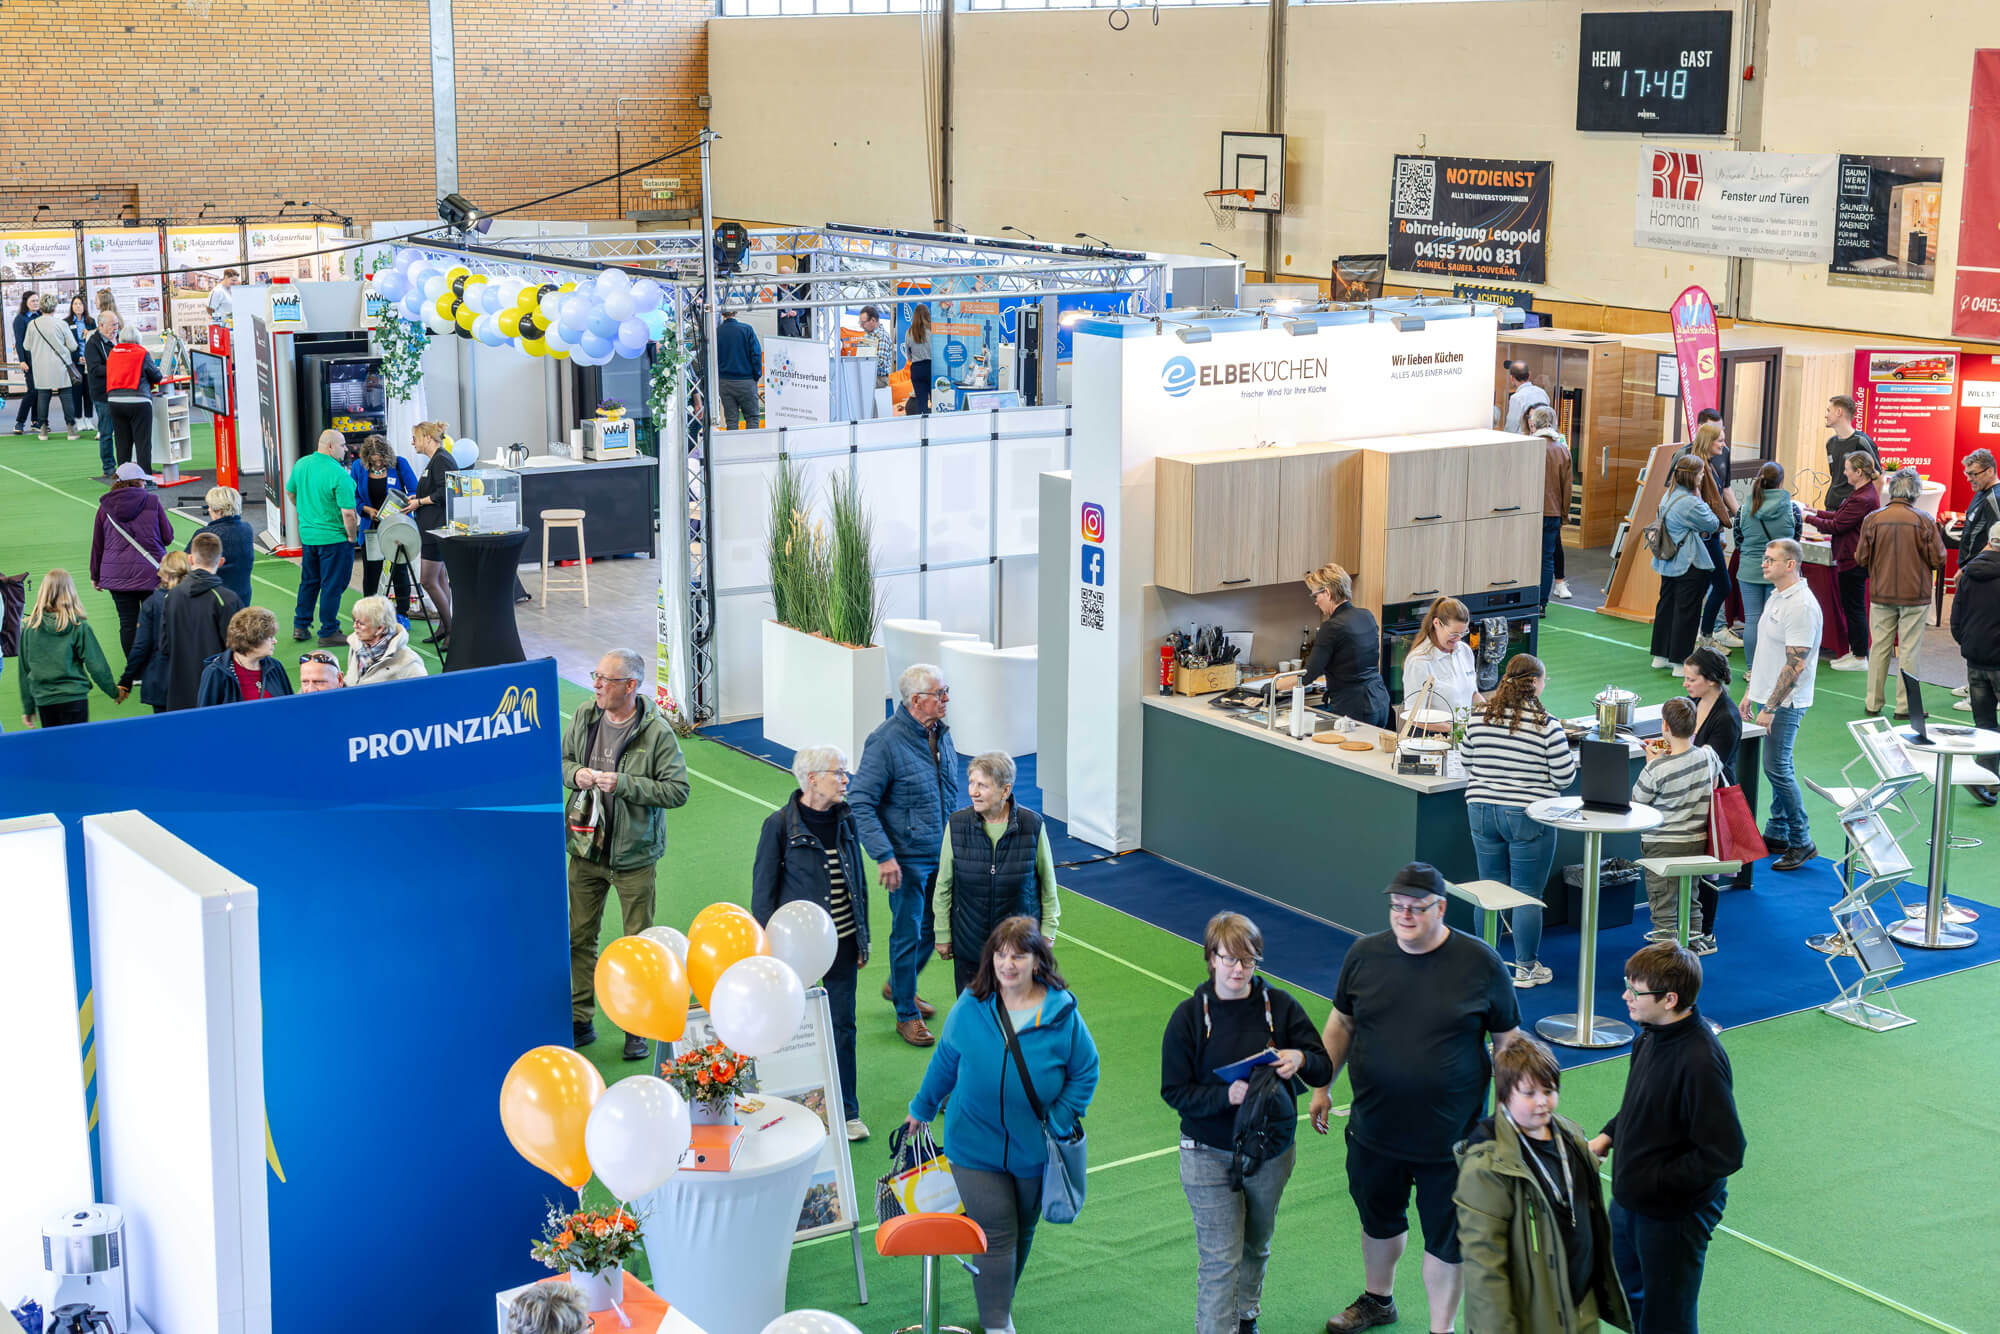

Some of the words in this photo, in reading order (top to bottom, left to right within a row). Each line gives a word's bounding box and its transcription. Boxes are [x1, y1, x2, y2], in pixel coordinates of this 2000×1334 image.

[1591, 51, 1621, 67] HEIM
[1680, 50, 1713, 67] GAST
[1620, 70, 1689, 99] 17:48
[1446, 167, 1536, 188] NOTDIENST
[1845, 168, 1867, 176] SAUNA
[643, 180, 679, 188] Notausgang
[1721, 190, 1757, 203] Fenster
[1758, 193, 1777, 203] und
[1779, 192, 1809, 205] Türen
[1651, 201, 1700, 212] TISCHLEREI
[1840, 203, 1869, 212] SAUNEN
[1649, 209, 1700, 230] Hamann
[1840, 212, 1876, 221] INFRAROT-
[1839, 221, 1869, 230] KABINEN
[1399, 220, 1486, 243] Rohrreinigung
[1488, 227, 1541, 246] Leopold
[1838, 239, 1870, 248] ZUHAUSE
[1414, 241, 1455, 260] 04155
[1458, 245, 1493, 262] 7000
[1496, 248, 1521, 265] 831
[1416, 259, 1447, 270] SCHNELL.
[1447, 262, 1476, 273] SAUBER.
[1476, 265, 1518, 276] SOUVERÄN.
[1477, 292, 1514, 306] ACHTUNG
[1391, 355, 1407, 367] Wir
[1407, 353, 1433, 366] lieben
[1435, 351, 1464, 364] Küchen
[770, 369, 827, 383] Wirtschaftsverbund
[1200, 357, 1328, 387] ELBEKÜCHEN
[1390, 371, 1410, 379] ALLES
[1411, 370, 1423, 378] AUS
[1424, 369, 1444, 377] EINER
[1444, 367, 1463, 375] HAND
[1240, 389, 1265, 399] frischer
[1266, 388, 1282, 397] Wind
[1283, 387, 1293, 396] für
[1294, 386, 1307, 395] Ihre
[1307, 385, 1328, 395] Küche
[1967, 390, 1996, 398] WILLST
[348, 710, 531, 763] PROVINZIAL
